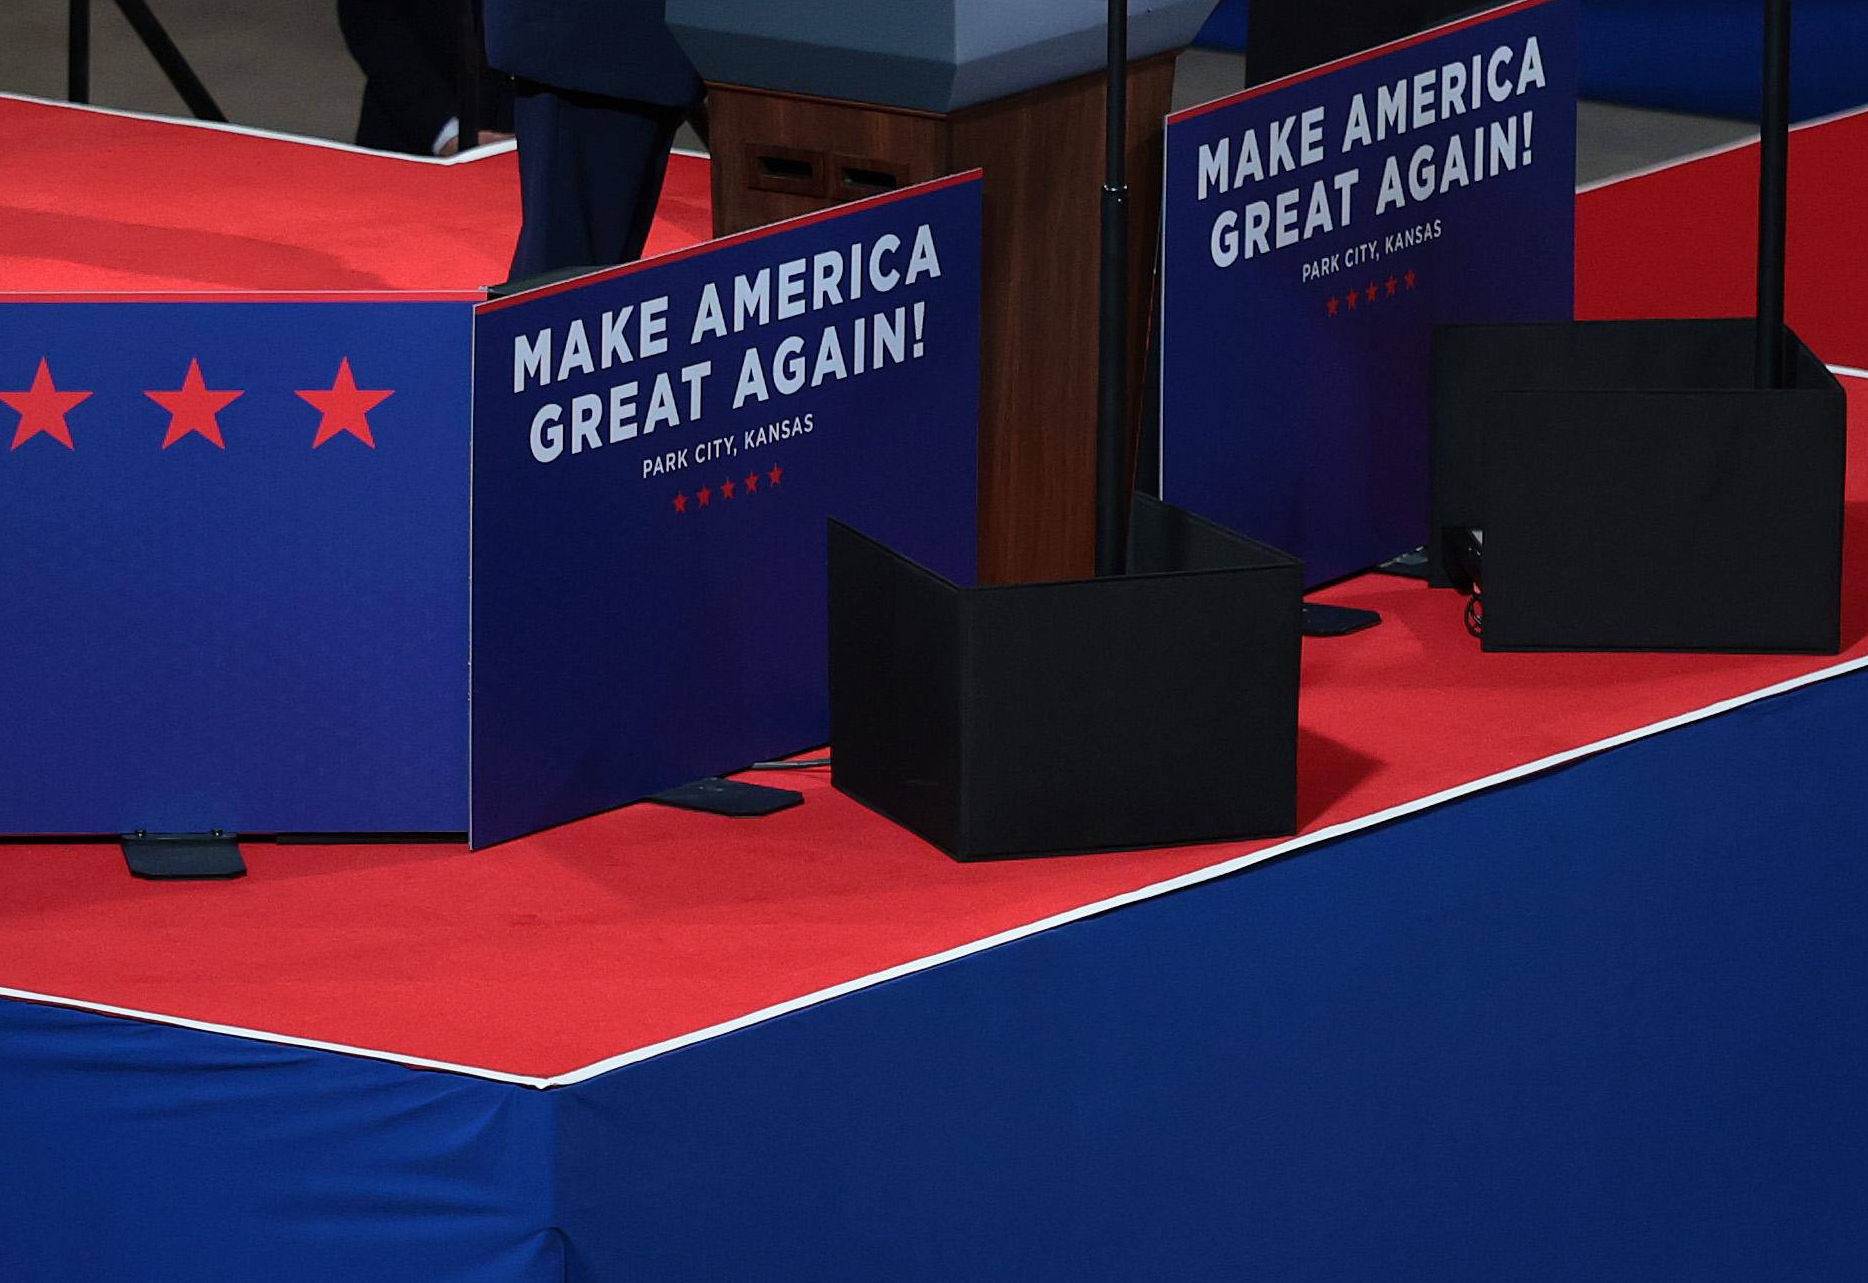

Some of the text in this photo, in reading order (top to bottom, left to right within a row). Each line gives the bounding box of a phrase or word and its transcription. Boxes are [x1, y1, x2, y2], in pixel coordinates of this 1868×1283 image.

[1197, 36, 1546, 200] MAKE AMERICA
[1210, 111, 1533, 268] GREAT AGAIN!
[514, 224, 941, 393] MAKE AMERICA
[1302, 219, 1442, 283] PARK CITY, KANSAS
[531, 301, 926, 463] GREAT AGAIN!
[642, 413, 814, 478] PARK CITY, KANSAS
